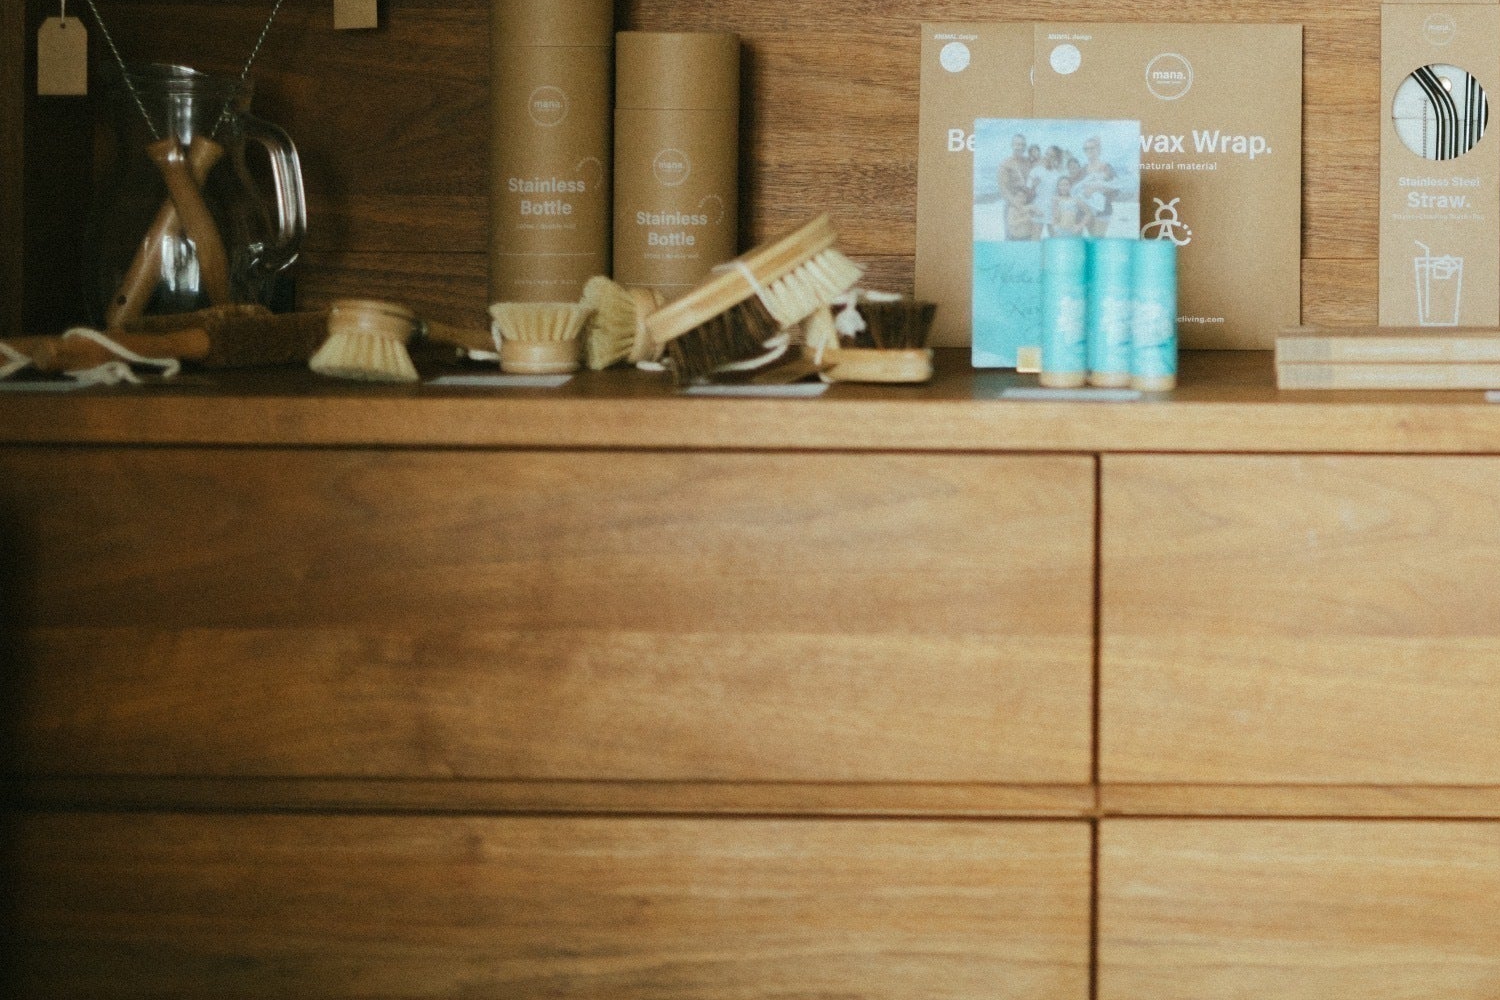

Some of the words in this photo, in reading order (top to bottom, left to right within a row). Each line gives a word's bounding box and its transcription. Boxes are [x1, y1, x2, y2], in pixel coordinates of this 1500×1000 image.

[1152, 71, 1186, 80] mana.
[1192, 130, 1272, 159] Wrap.
[1177, 162, 1217, 171] material
[508, 177, 586, 193] Stainless
[1398, 176, 1448, 188] Stainless
[1451, 176, 1480, 188] Steel
[1407, 191, 1471, 209] Straw.
[520, 200, 573, 216] Bottle
[636, 211, 708, 225] Stainless
[647, 232, 696, 246] Bottle
